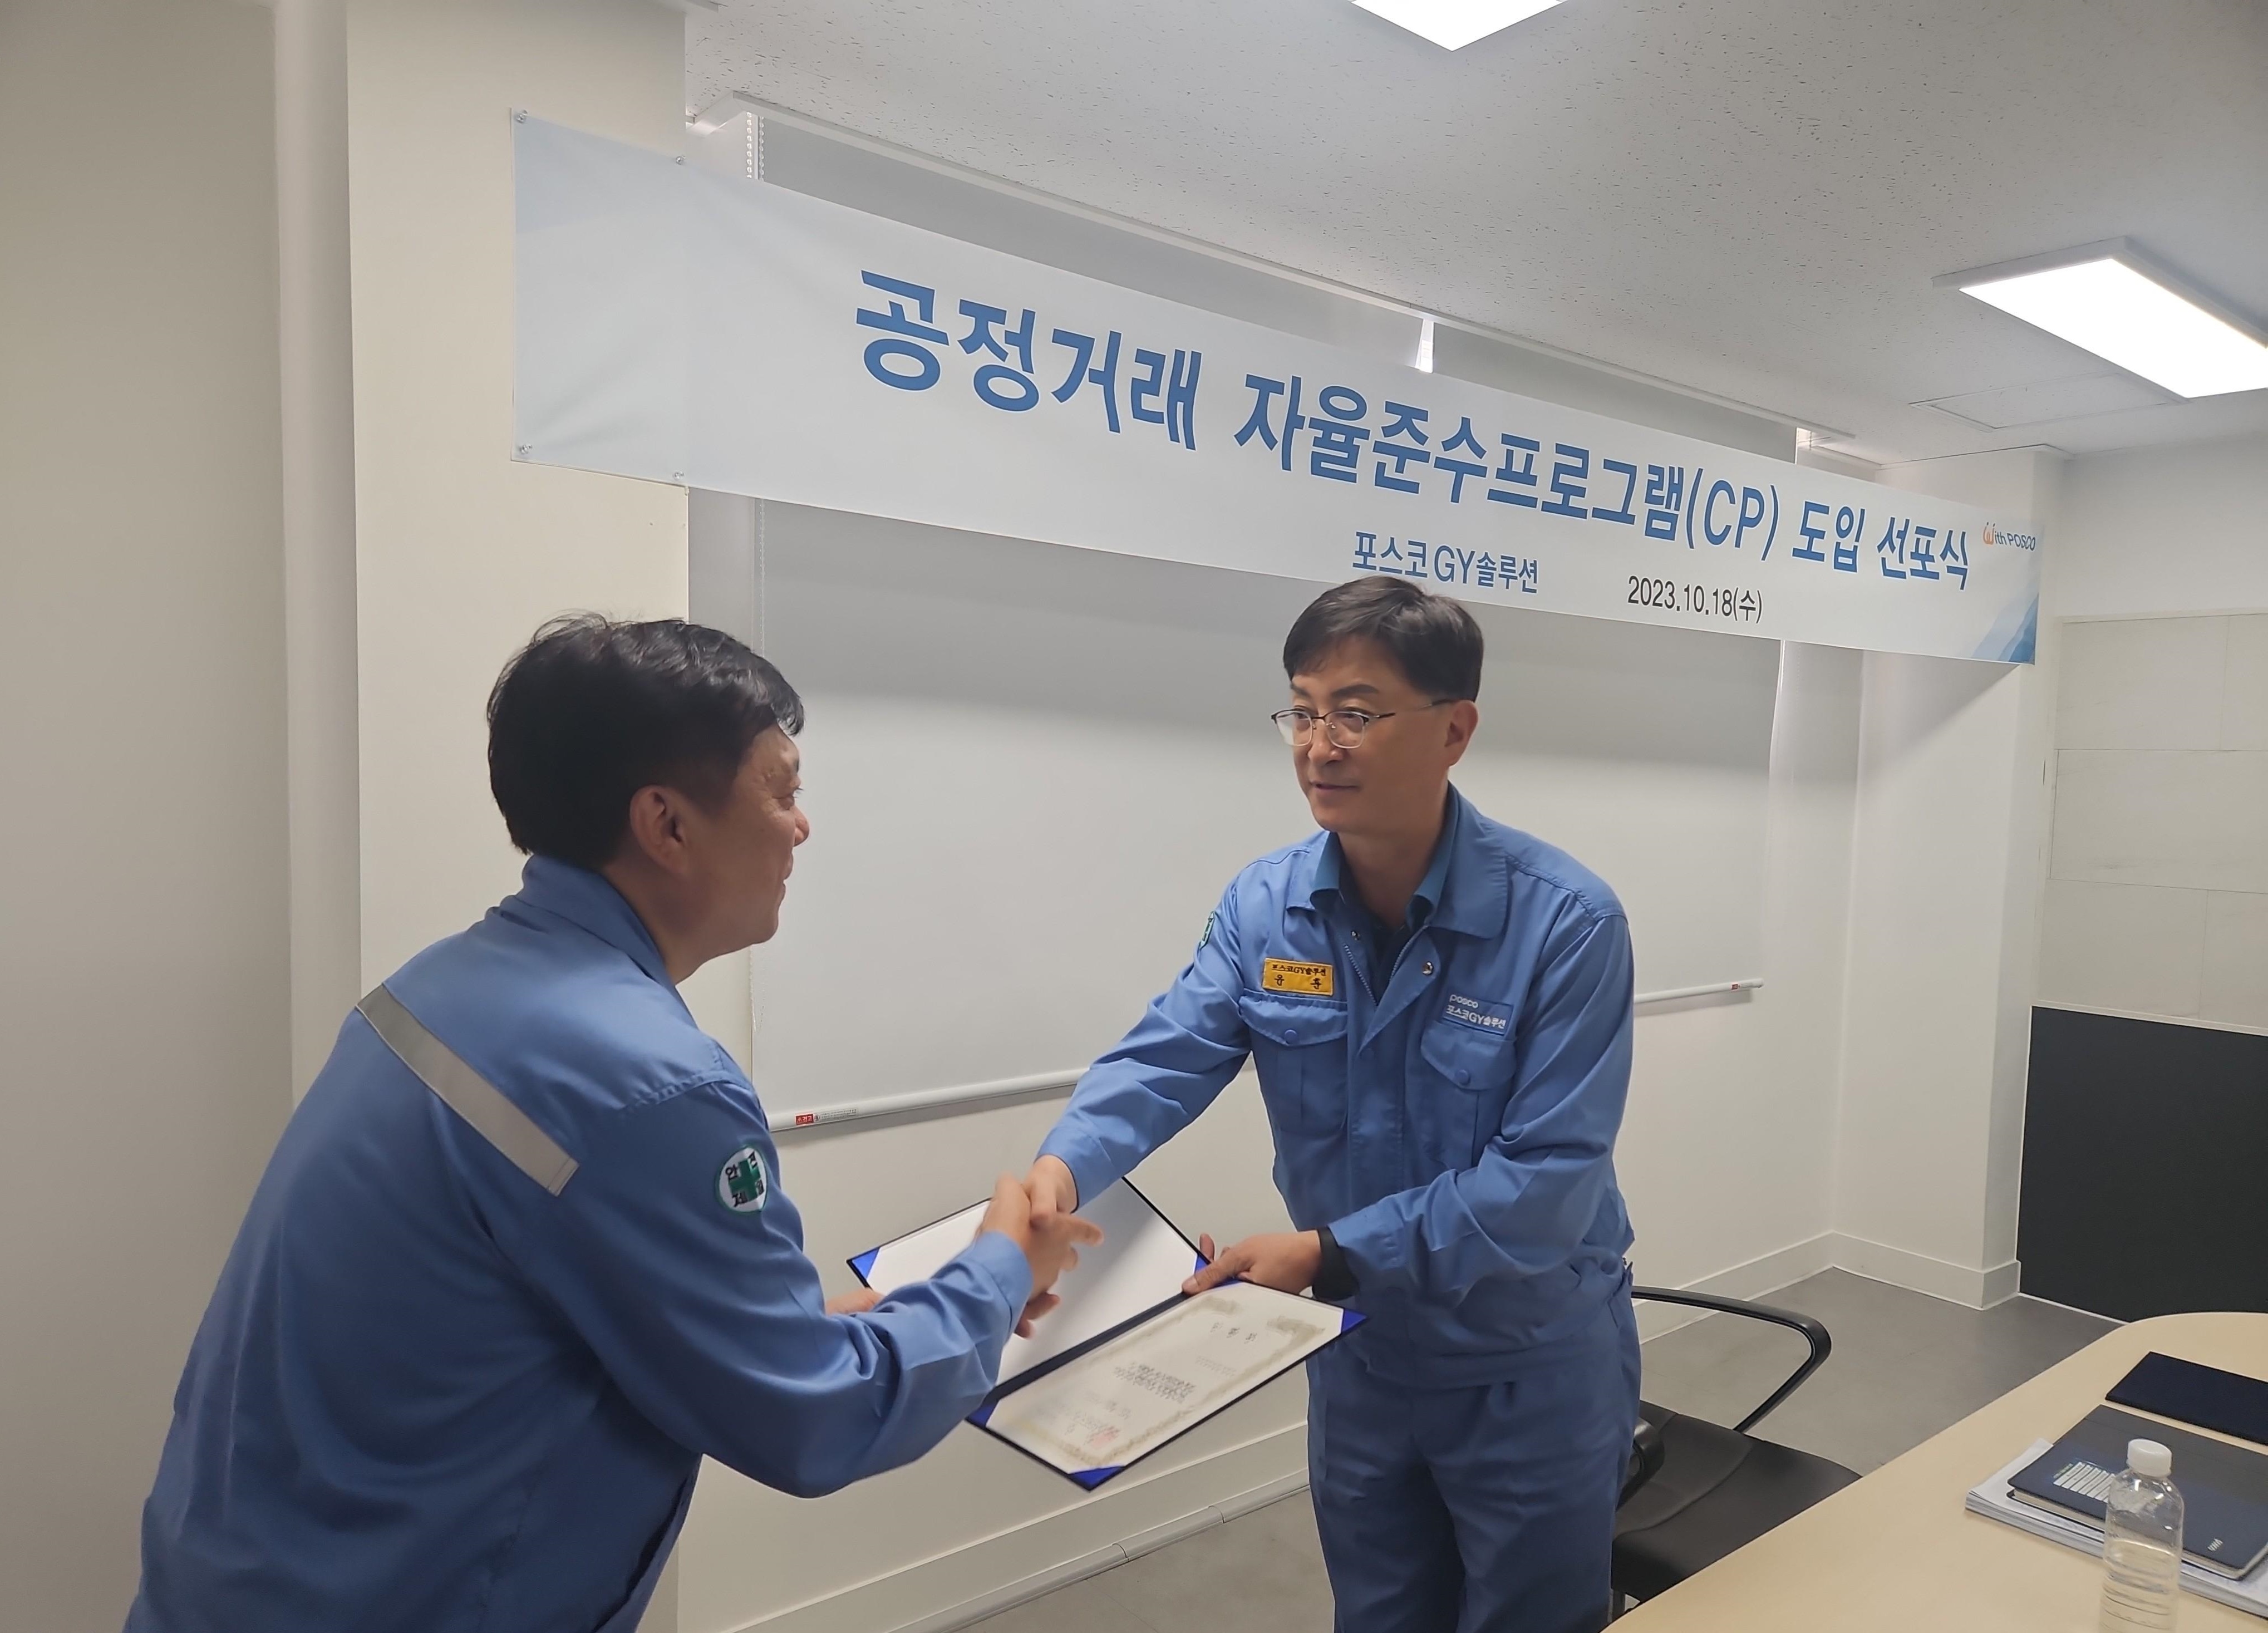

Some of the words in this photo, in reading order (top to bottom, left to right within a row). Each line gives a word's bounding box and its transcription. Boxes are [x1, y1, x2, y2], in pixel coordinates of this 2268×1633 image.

[856, 270, 1202, 451] 공정거래
[1233, 373, 1779, 561] 자율준수프로그램(CP)
[1792, 501, 1866, 573] 도입
[1877, 517, 1969, 591] 선포식
[1352, 532, 1538, 594] 포스코GY솔루션
[2007, 533, 2036, 551] POSCO
[1628, 576, 1763, 623] 2023.10.18(수)
[1446, 1004, 1506, 1029] 포스코GY솔루션
